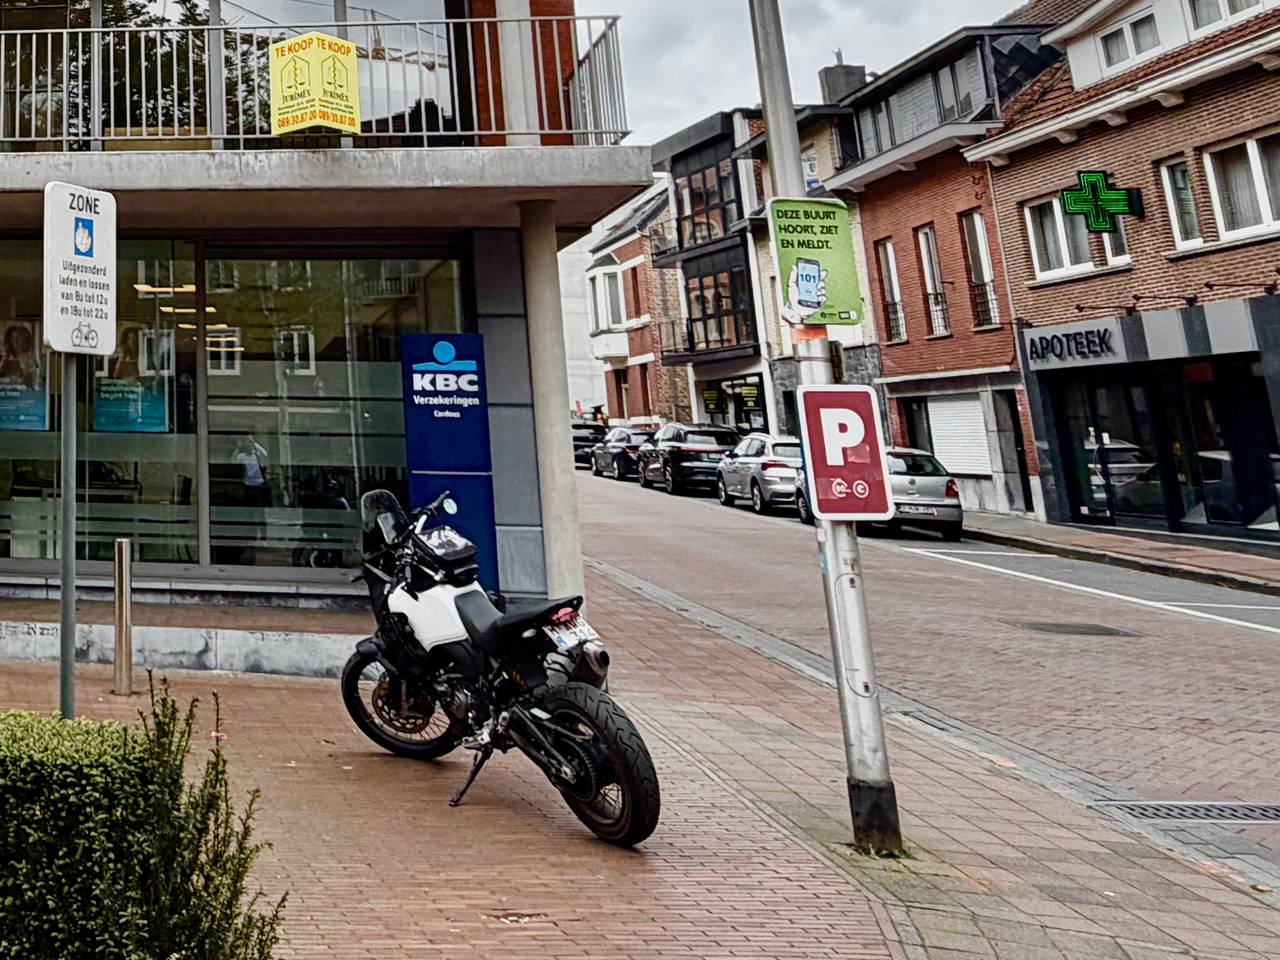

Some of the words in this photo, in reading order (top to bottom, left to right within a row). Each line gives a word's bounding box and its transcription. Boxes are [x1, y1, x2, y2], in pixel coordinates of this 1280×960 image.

[275, 47, 286, 58] TE
[288, 38, 313, 54] KOOP
[316, 38, 326, 49] TE
[328, 41, 351, 56] KOOP
[69, 193, 100, 215] ZONE
[776, 209, 801, 219] DEZE
[804, 210, 836, 220] BUURT
[778, 225, 817, 235] HOORT,
[819, 225, 839, 235] ZIET
[781, 239, 795, 249] EN
[797, 239, 832, 249] MELDT.
[63, 260, 107, 277] Uitgezonderd
[59, 274, 78, 287] laden
[79, 279, 87, 288] en
[89, 278, 110, 290] lossen
[800, 274, 816, 284] 101
[61, 292, 74, 301] van
[75, 290, 83, 302] 8u
[85, 292, 95, 303] tot
[96, 293, 108, 305] 12u
[60, 306, 69, 315] en
[70, 305, 82, 317] 18u
[83, 306, 93, 318] tot
[95, 307, 109, 320] 22u
[1030, 328, 1112, 360] APOTEEK
[412, 373, 479, 392] KBC
[413, 395, 479, 407] Verzekeringen
[819, 408, 865, 466] P
